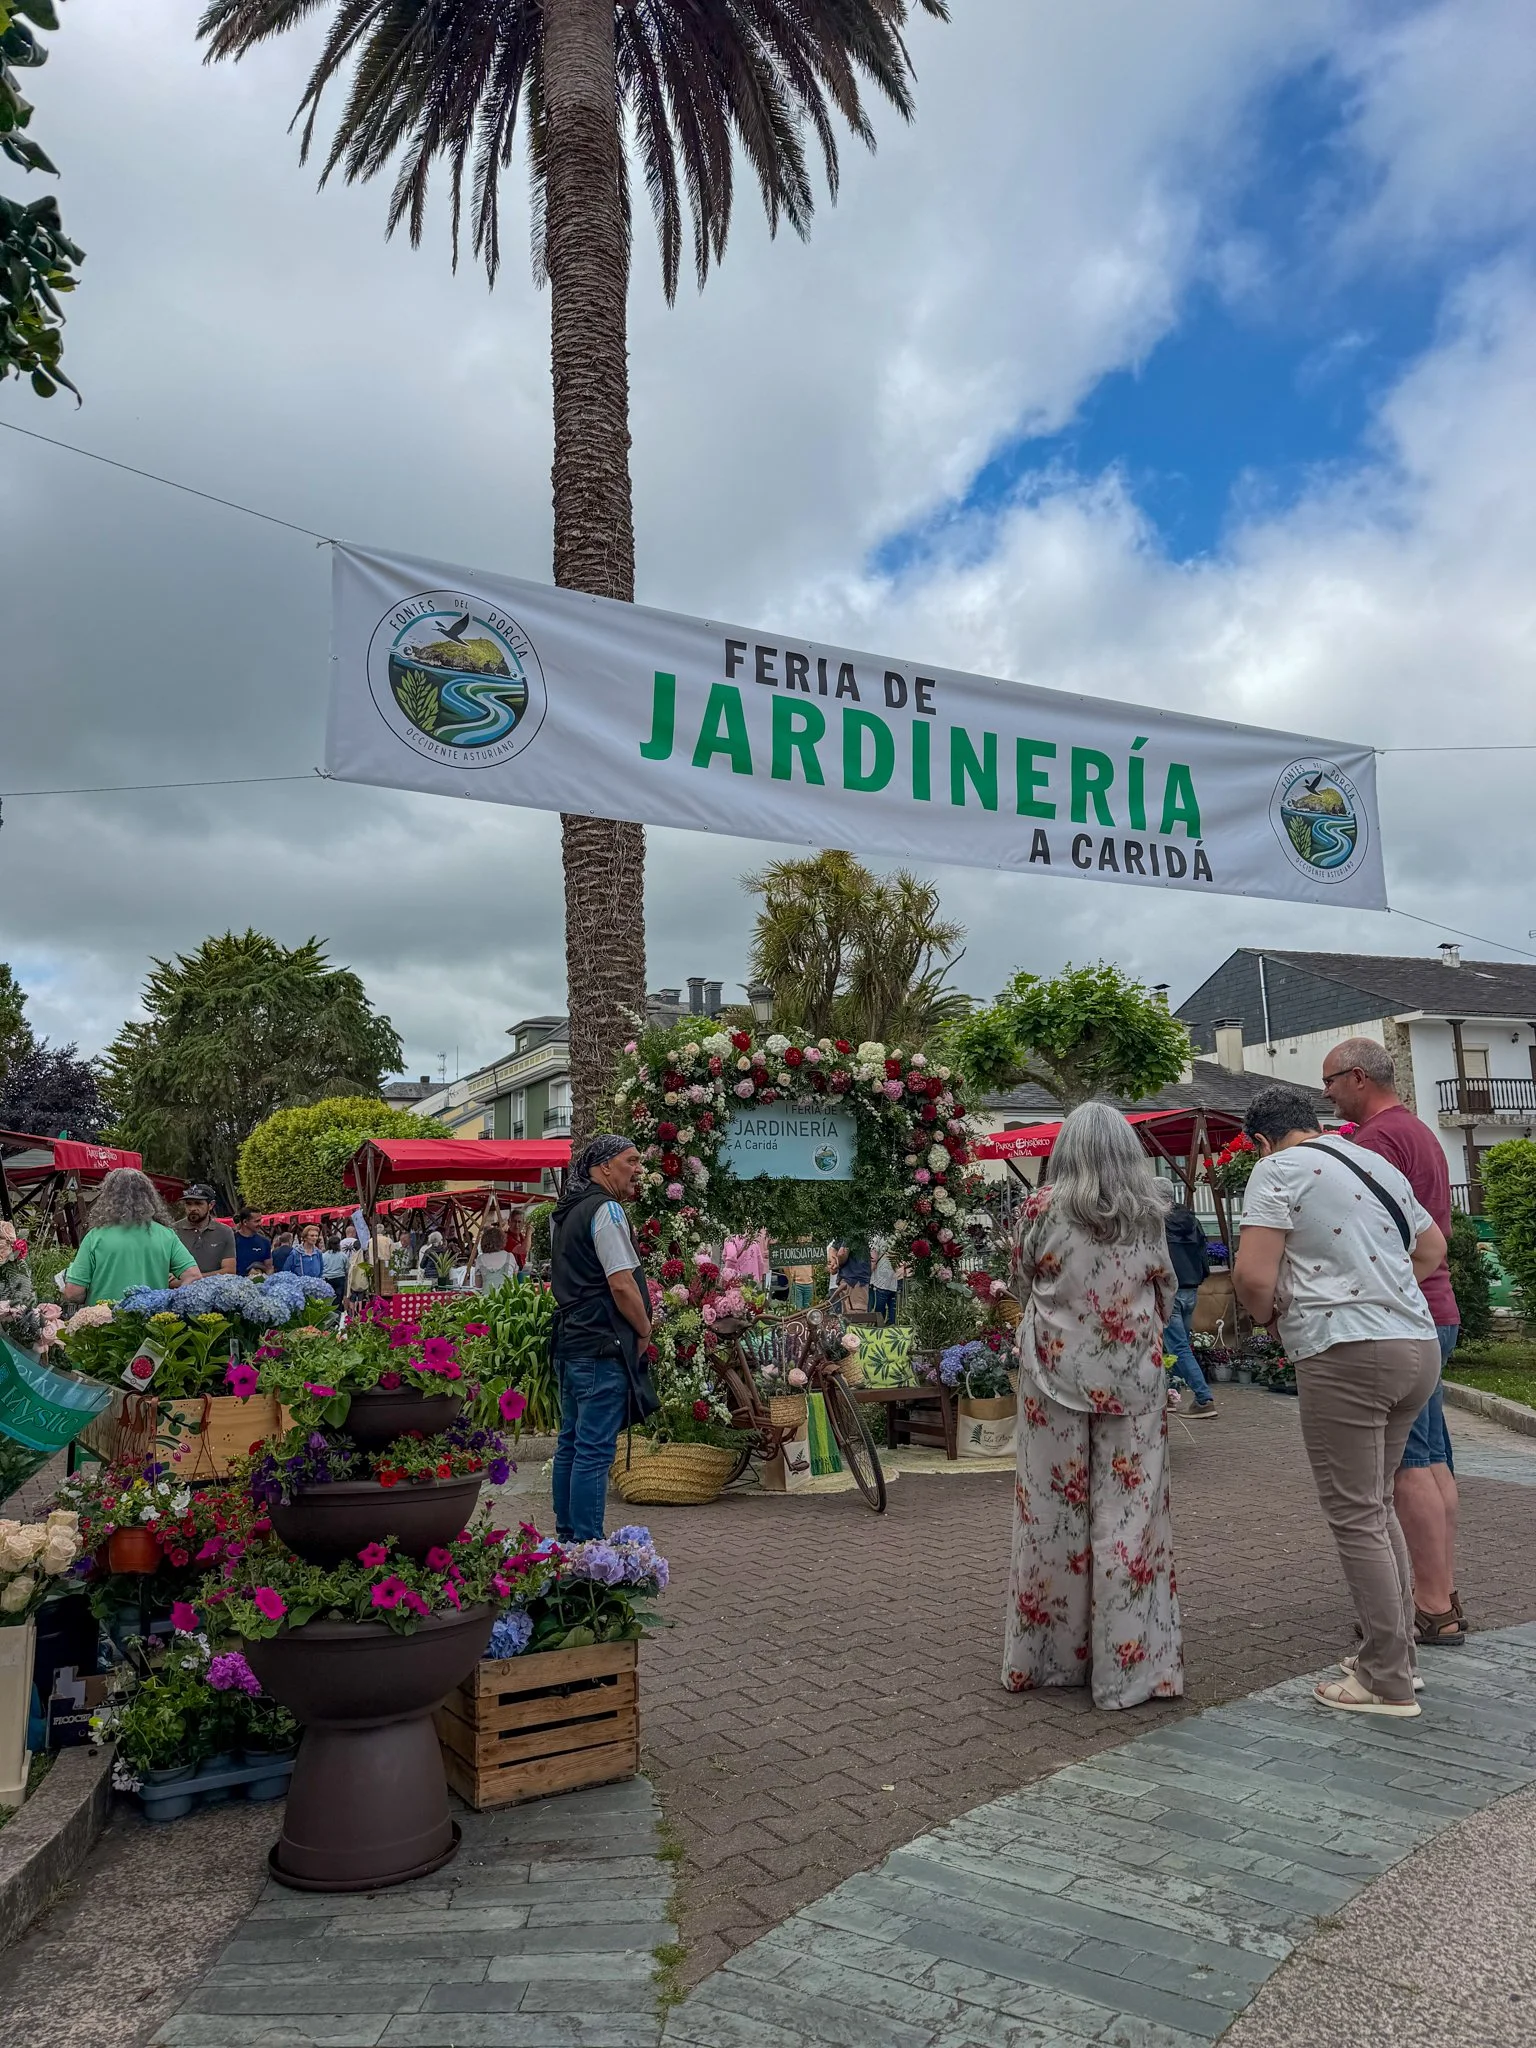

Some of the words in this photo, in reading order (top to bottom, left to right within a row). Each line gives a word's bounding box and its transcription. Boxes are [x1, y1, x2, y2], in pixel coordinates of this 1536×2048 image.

[389, 600, 435, 631] FONTES
[454, 599, 469, 609] DEL
[487, 612, 528, 659] PORCÍA
[725, 638, 861, 702] FERIA
[884, 670, 937, 715] DE
[406, 727, 459, 760] OCCIDENTE
[463, 740, 514, 761] ASTURIANO
[639, 670, 1202, 839] JARDINERÍA
[1282, 764, 1305, 790] FONTES
[1029, 828, 1051, 865] A
[1071, 833, 1214, 882] CARIDÁ
[1295, 857, 1325, 878] OCCIDENTE
[1327, 860, 1354, 878] ASTURIANO
[792, 1105, 821, 1114] FERIA
[825, 1105, 837, 1115] DE
[735, 1118, 838, 1137] JARDINERÍA
[734, 1140, 741, 1150] A
[745, 1140, 778, 1150] Caridá
[1, 1385, 79, 1435] Mystic
